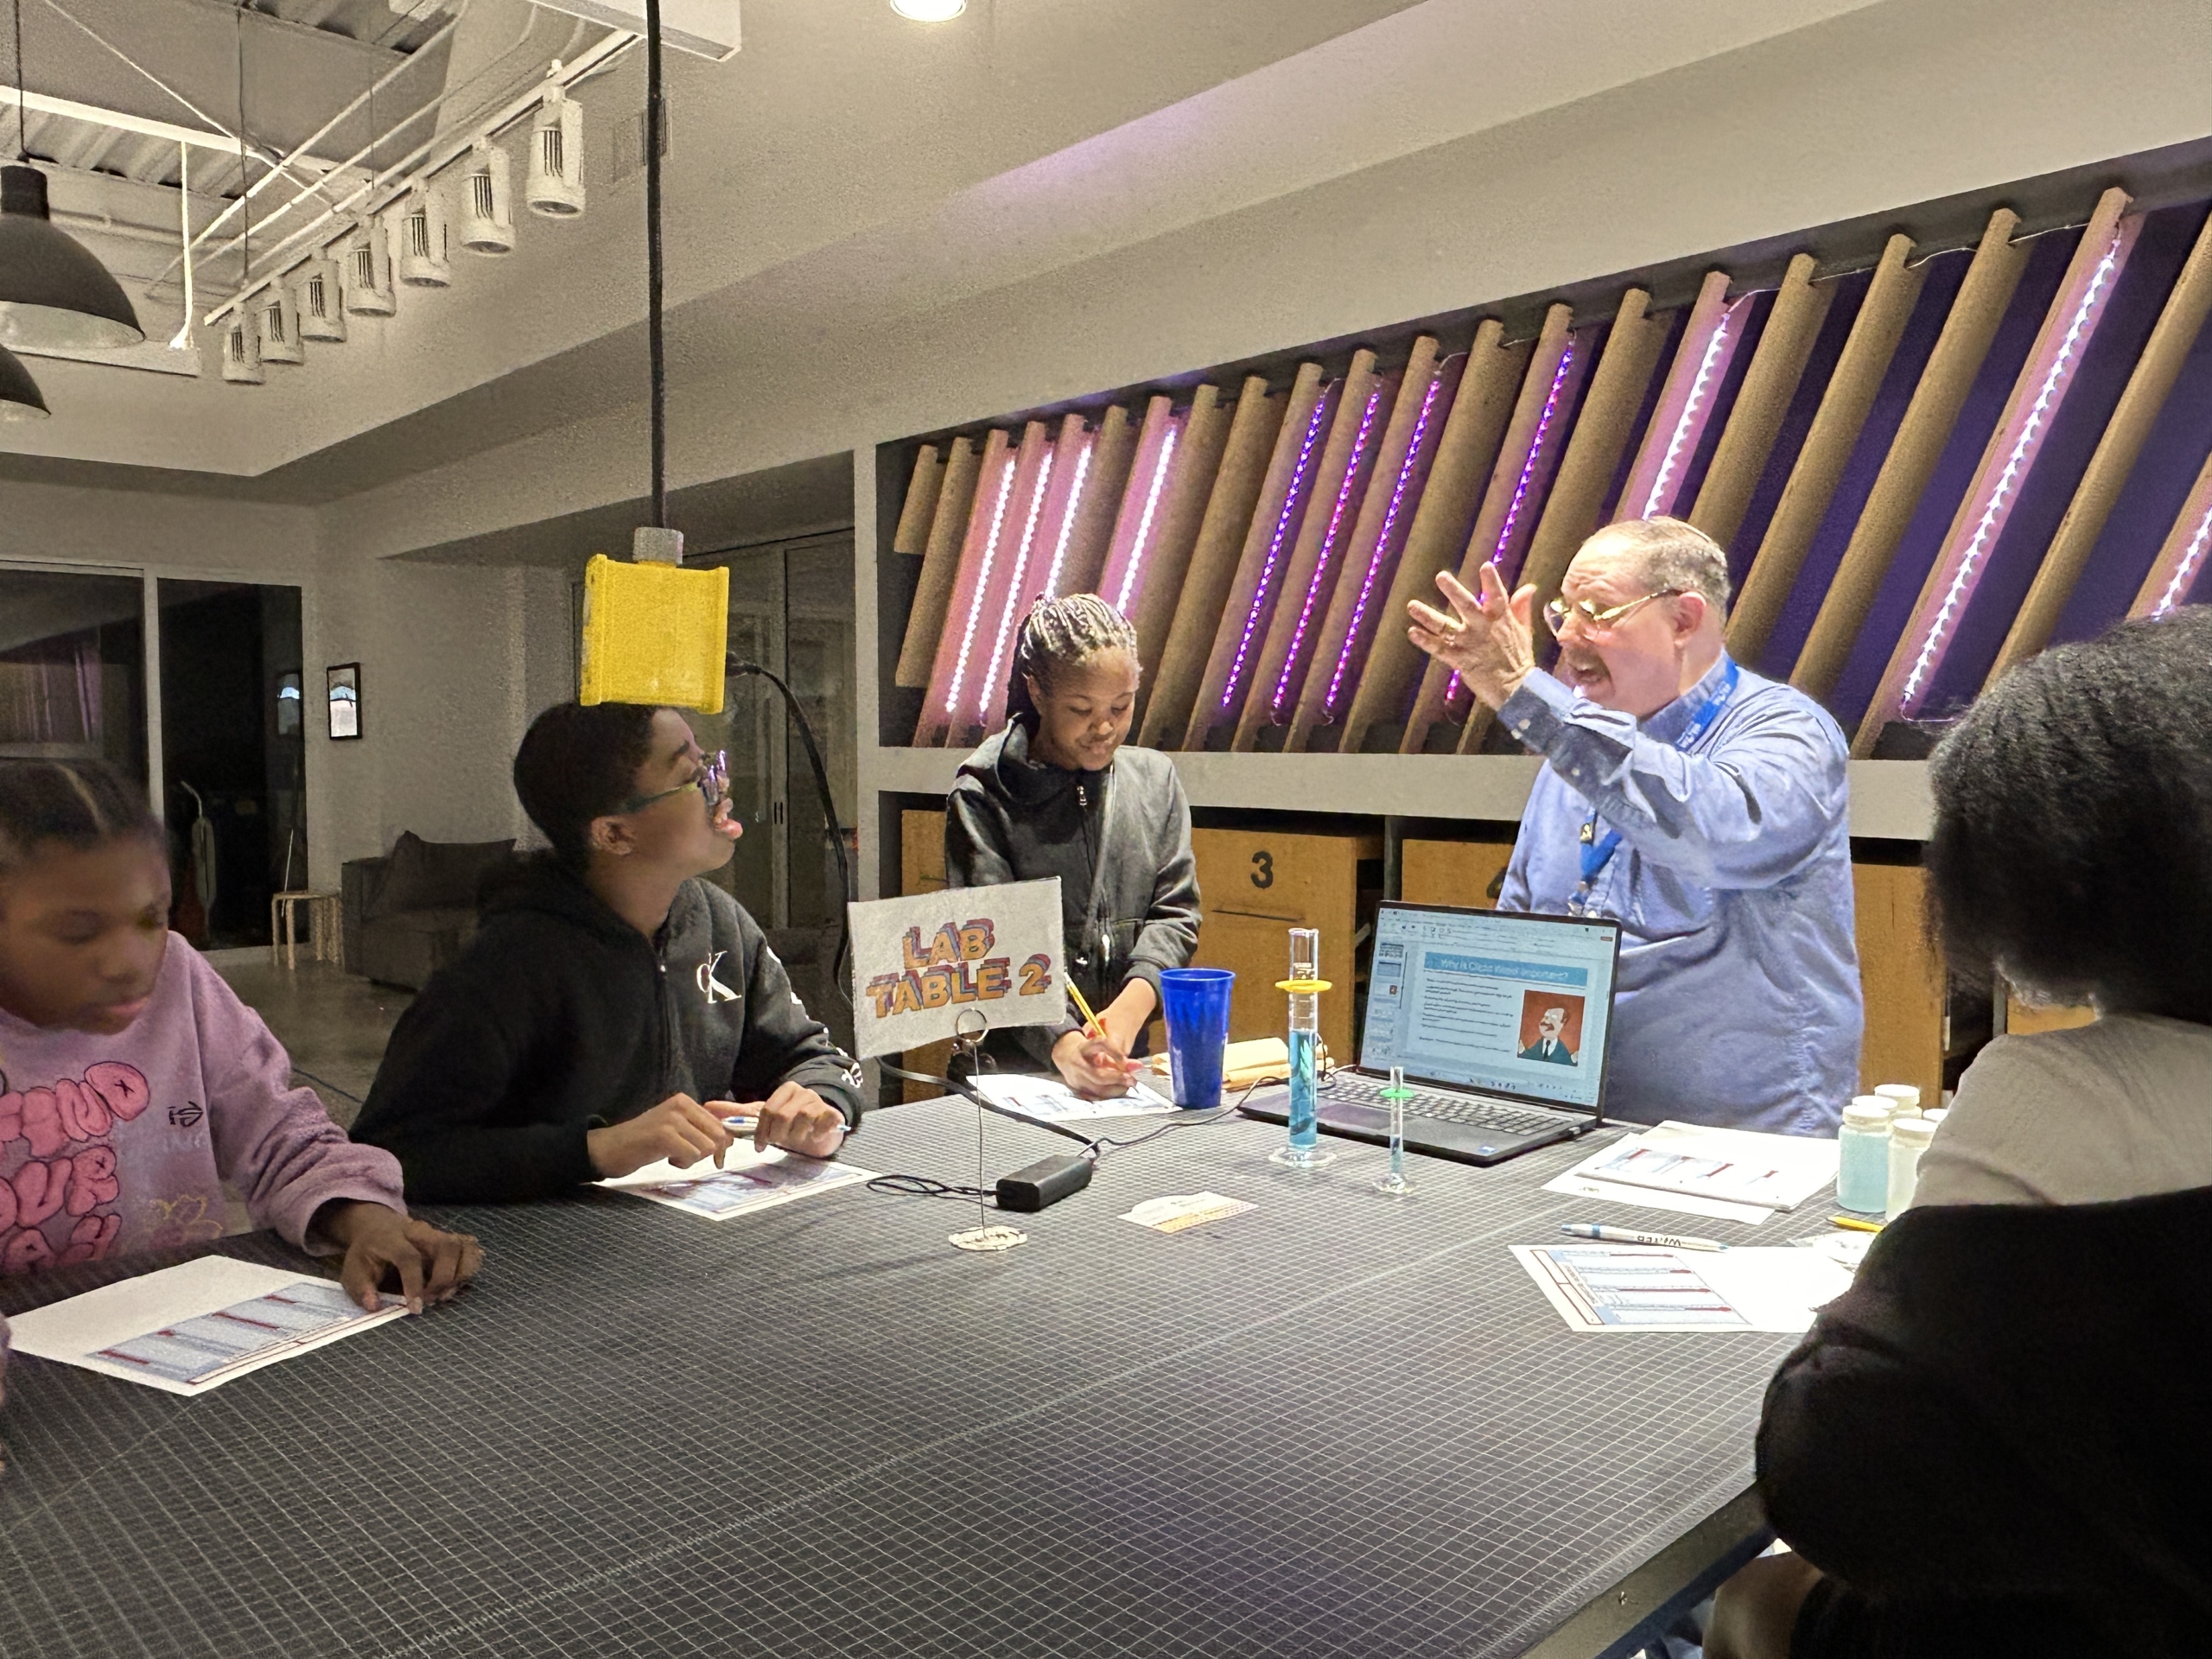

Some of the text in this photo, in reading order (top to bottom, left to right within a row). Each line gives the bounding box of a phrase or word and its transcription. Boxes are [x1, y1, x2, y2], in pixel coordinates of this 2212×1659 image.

[1250, 850, 1274, 888] 3
[902, 918, 995, 969] LAB
[866, 957, 1012, 1018] TABLE
[1019, 953, 1052, 995] 2
